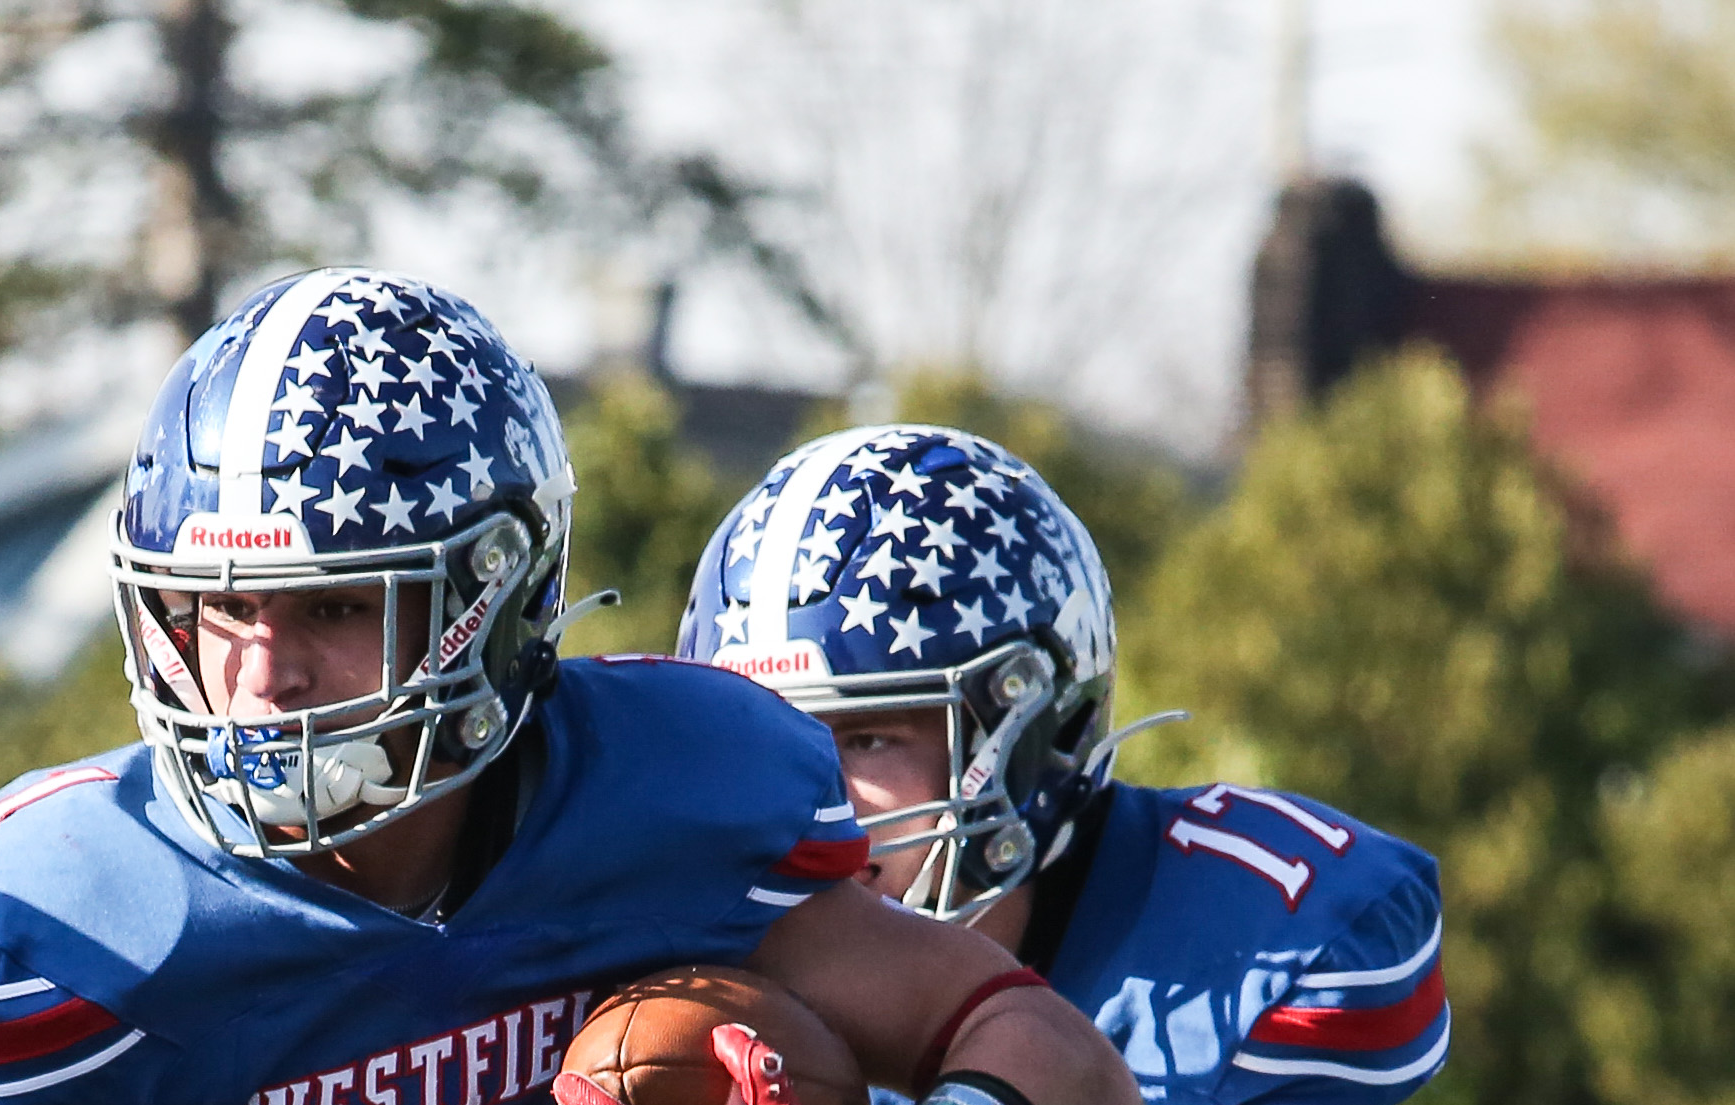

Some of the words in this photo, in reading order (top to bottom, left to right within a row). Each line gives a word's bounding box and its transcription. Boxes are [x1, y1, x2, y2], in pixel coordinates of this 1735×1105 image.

[190, 525, 292, 549] Riddell
[420, 598, 488, 676] ddell
[1164, 782, 1356, 914] 17
